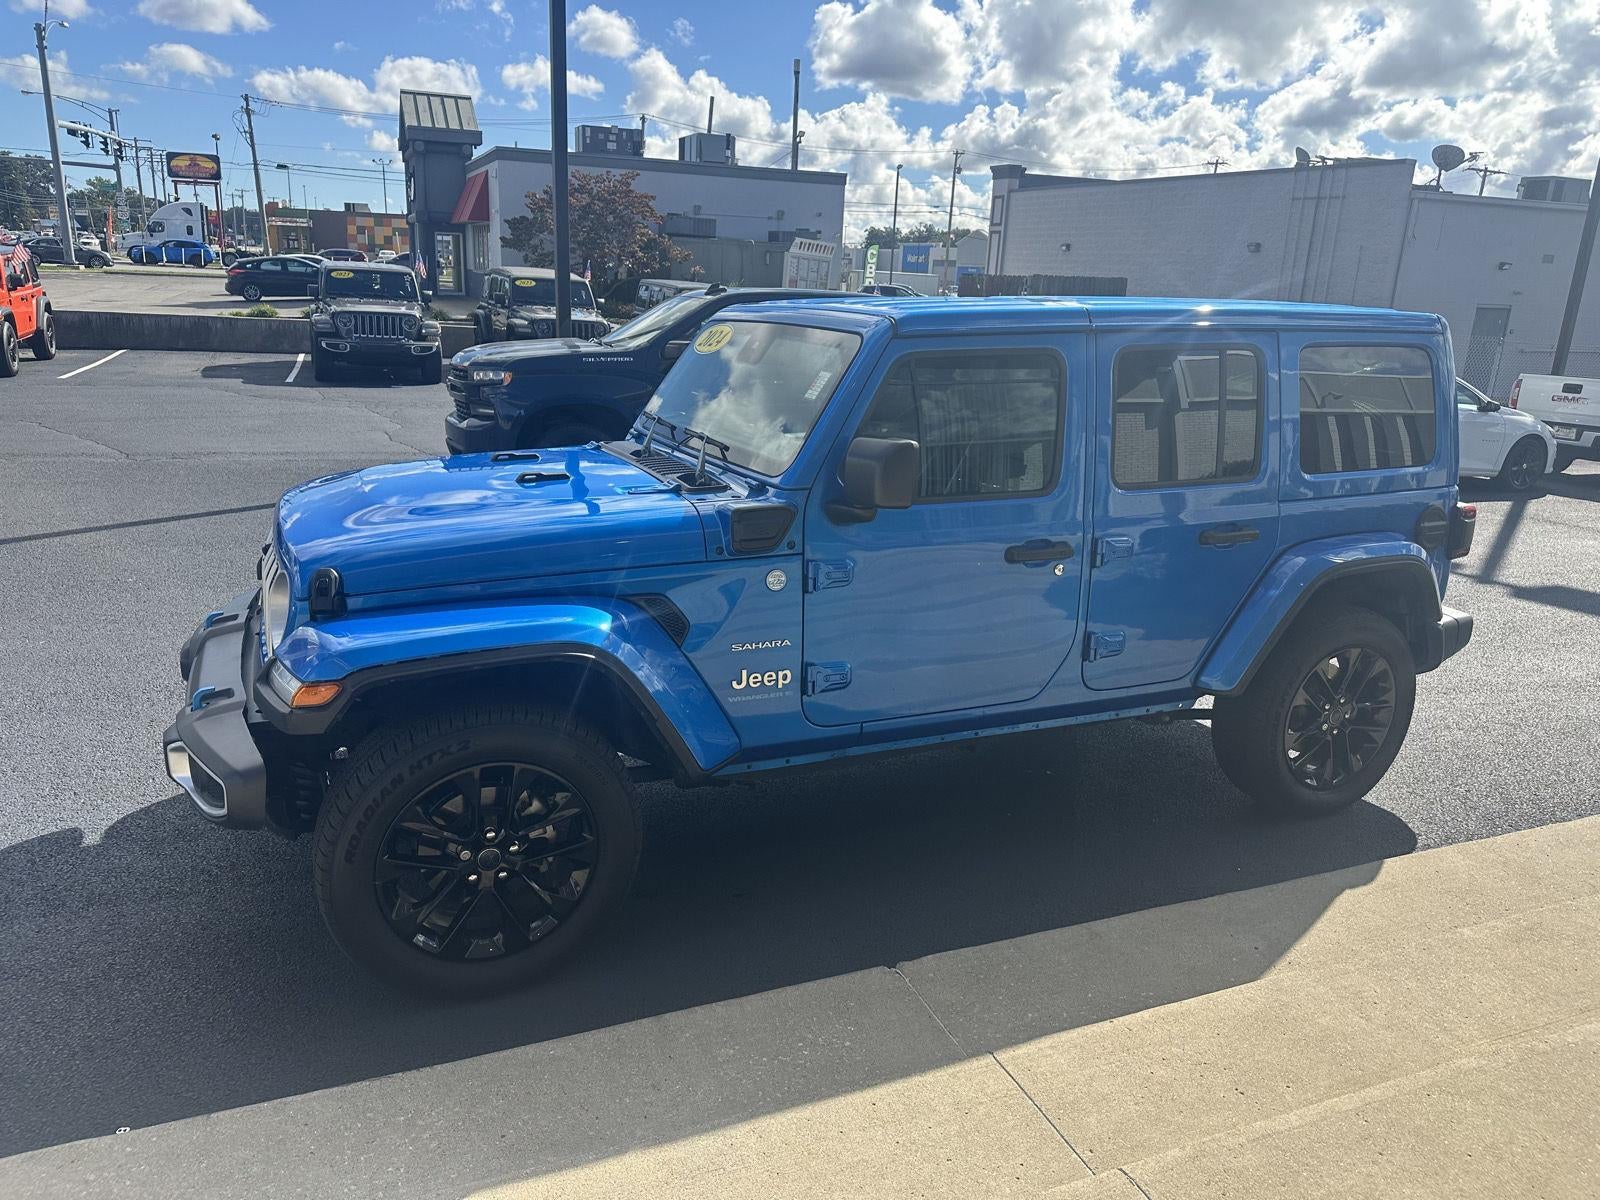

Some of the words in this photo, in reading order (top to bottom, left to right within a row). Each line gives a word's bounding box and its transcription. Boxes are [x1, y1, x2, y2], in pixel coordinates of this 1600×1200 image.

[697, 327, 731, 348] 2024
[1551, 394, 1589, 405] GMC
[731, 639, 792, 652] SAHARA
[731, 669, 792, 690] Jeep
